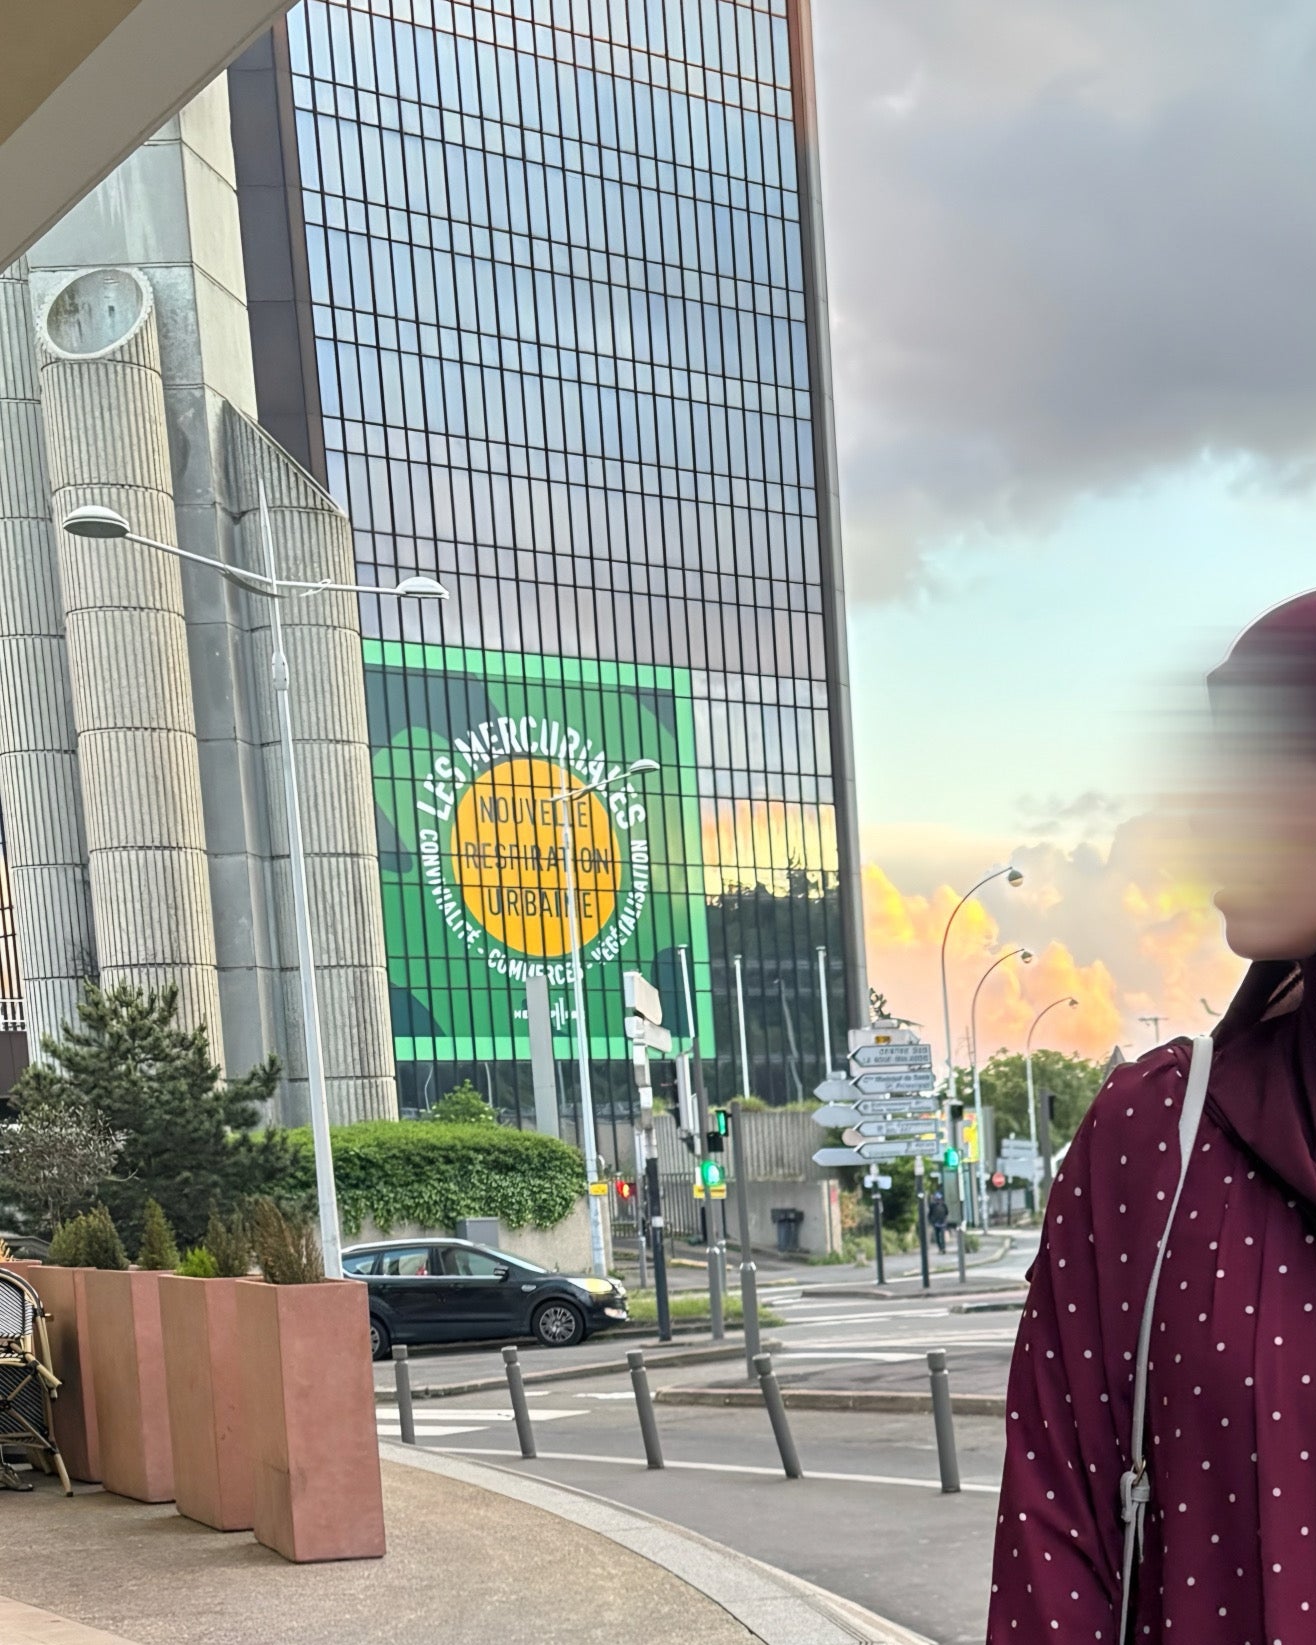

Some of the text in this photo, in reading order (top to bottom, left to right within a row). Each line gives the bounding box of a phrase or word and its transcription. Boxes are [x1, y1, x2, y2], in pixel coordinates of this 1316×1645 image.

[417, 716, 646, 830] LES MERCURIALES
[420, 829, 481, 949] CONVIVIALITÉ
[465, 842, 609, 875] RESPIRATON
